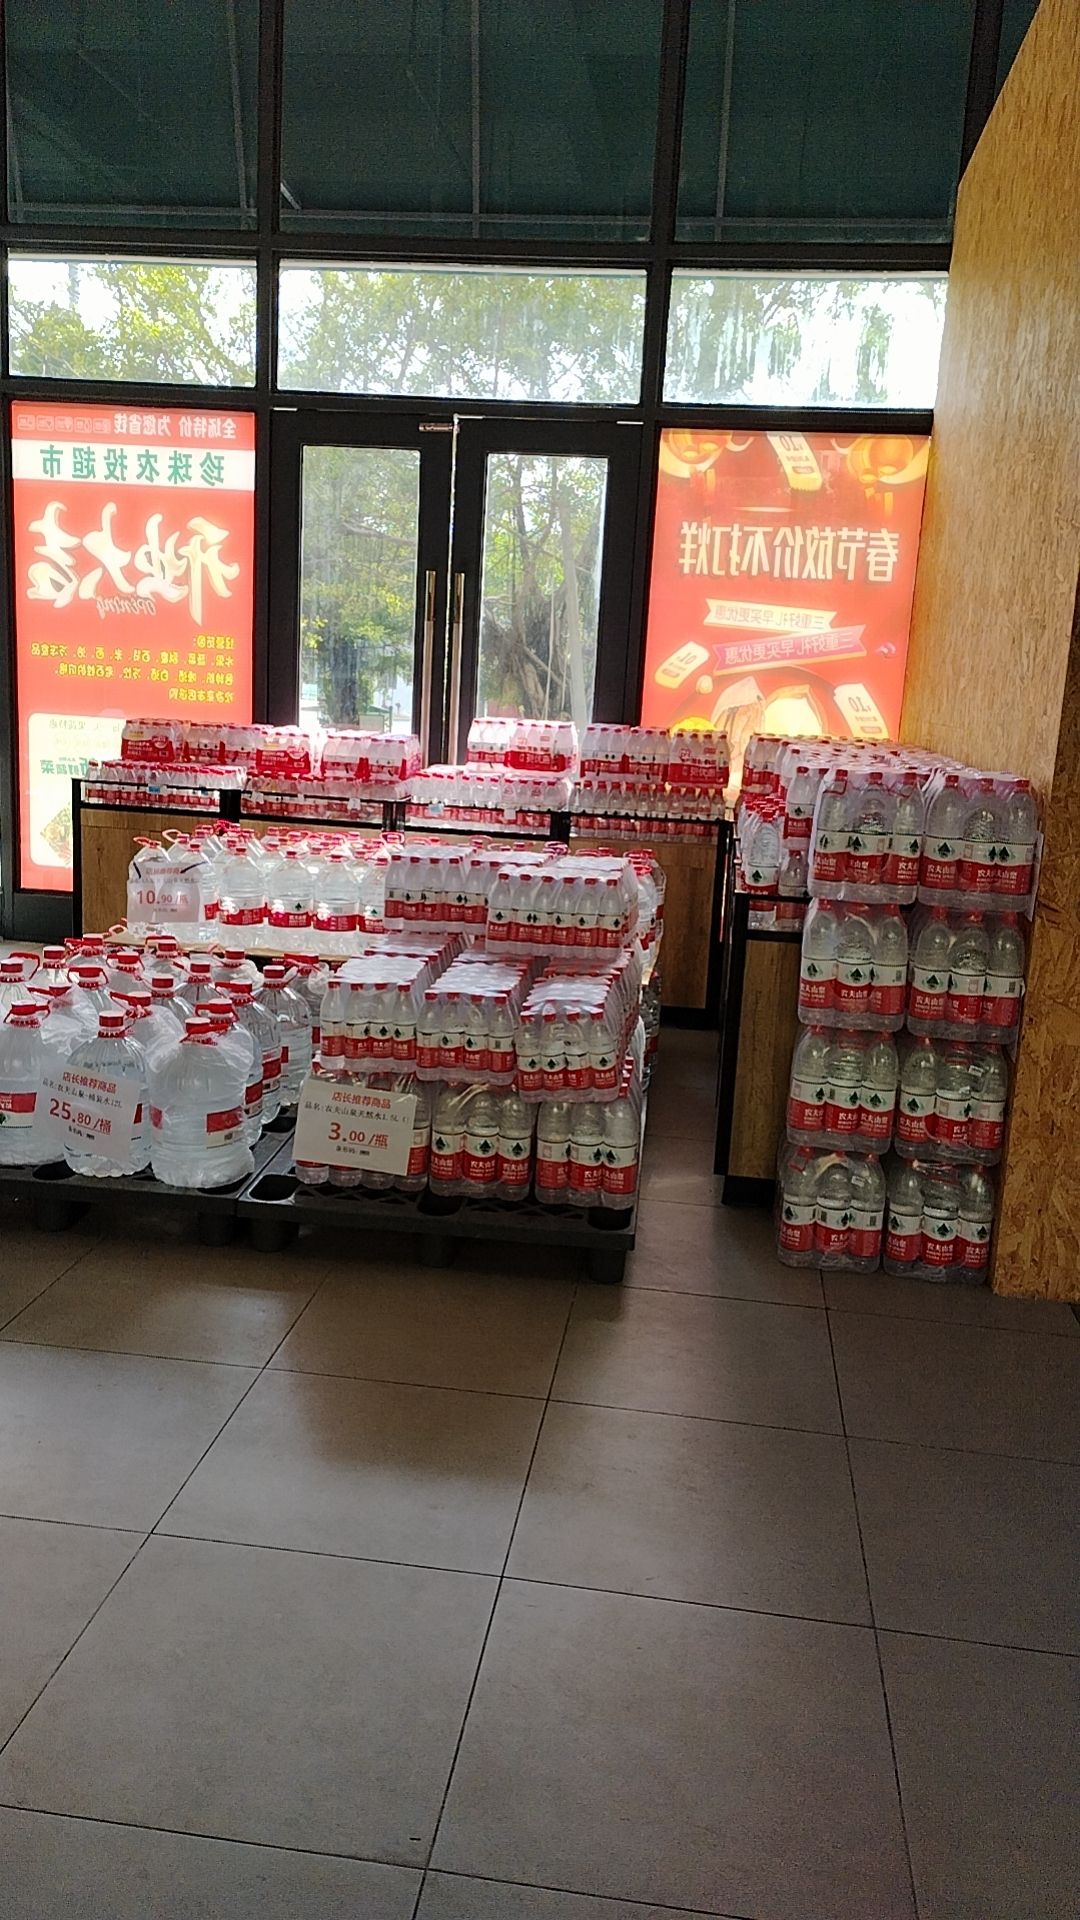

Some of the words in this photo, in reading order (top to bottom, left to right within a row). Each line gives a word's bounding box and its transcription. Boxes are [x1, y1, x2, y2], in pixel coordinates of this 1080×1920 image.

[62, 1071, 117, 1094] 店长推荐商品
[331, 1091, 392, 1110] 店长推荐商品
